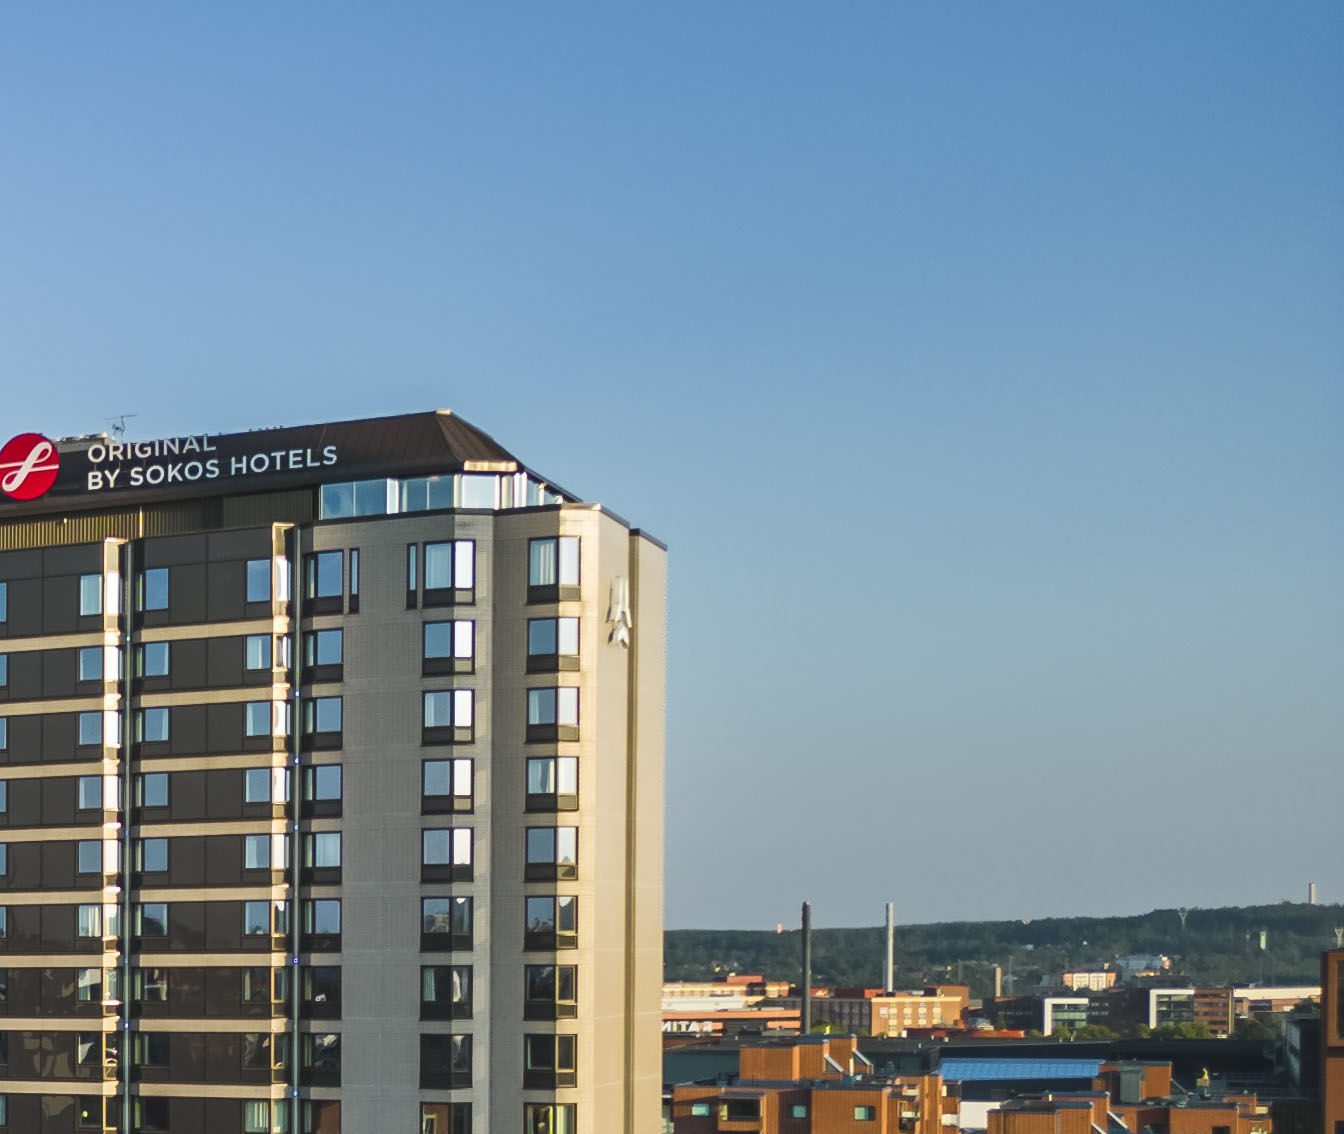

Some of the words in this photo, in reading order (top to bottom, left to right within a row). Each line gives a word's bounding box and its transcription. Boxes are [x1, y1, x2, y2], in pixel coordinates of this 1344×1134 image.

[87, 436, 217, 463] ORIGINAL
[87, 469, 120, 490] BY
[130, 460, 220, 486] SOKOS
[231, 446, 338, 475] HOTELS
